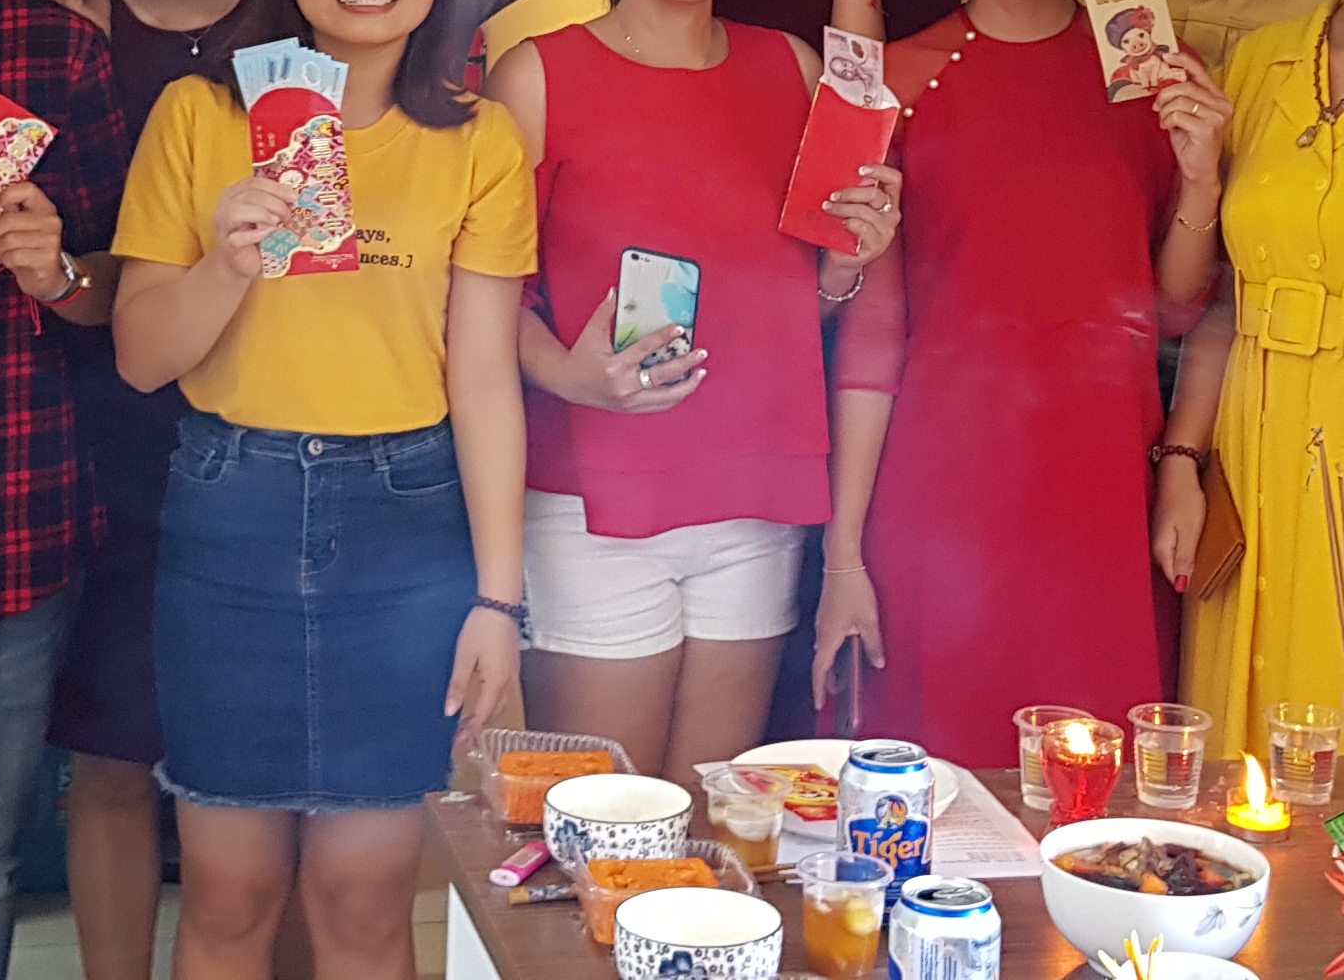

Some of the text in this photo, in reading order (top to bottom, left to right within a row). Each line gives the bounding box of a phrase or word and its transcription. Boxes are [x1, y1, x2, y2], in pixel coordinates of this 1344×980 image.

[355, 226, 392, 244] ays,
[359, 250, 414, 269] nces.]
[852, 830, 926, 870] Tiger
